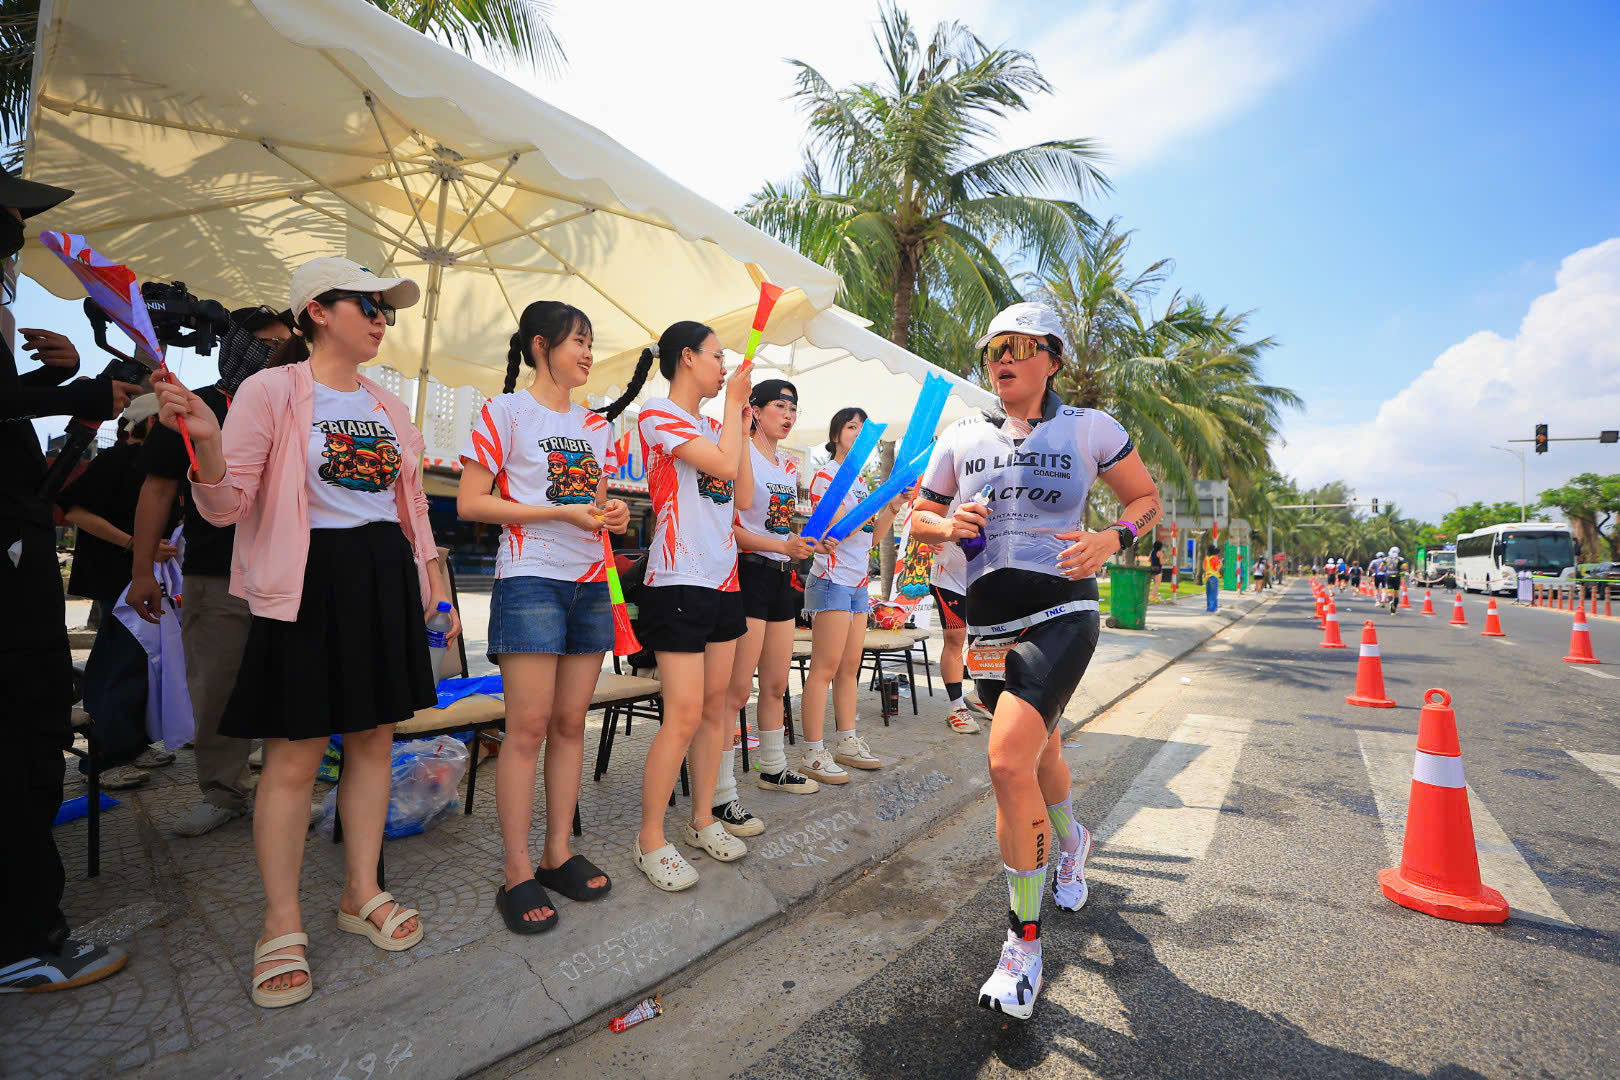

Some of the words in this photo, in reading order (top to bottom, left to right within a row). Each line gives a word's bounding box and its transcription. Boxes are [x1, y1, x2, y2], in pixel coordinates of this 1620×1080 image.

[146, 302, 166, 310] NIN
[965, 458, 986, 476] NO
[1033, 469, 1071, 480] COACHING
[987, 486, 1062, 504] ACTOR
[1044, 605, 1067, 618] TNLC
